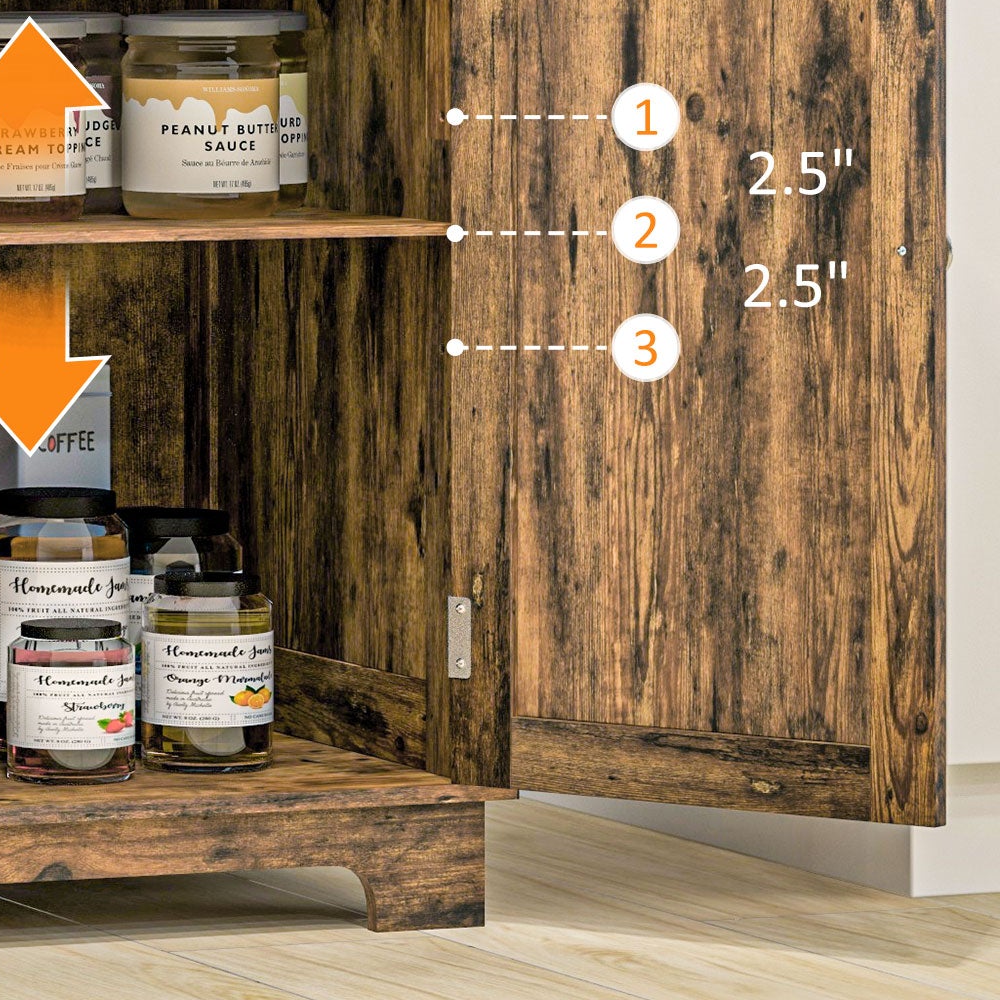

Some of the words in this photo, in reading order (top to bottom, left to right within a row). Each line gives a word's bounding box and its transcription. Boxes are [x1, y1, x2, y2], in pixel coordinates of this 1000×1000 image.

[161, 124, 229, 135] PEANUT
[204, 140, 256, 152] SAUCE
[38, 430, 95, 453] OFFEE
[9, 576, 102, 596] Homemade
[162, 645, 246, 658] Homemade
[34, 674, 113, 686] Homemade
[163, 673, 211, 687] Orange
